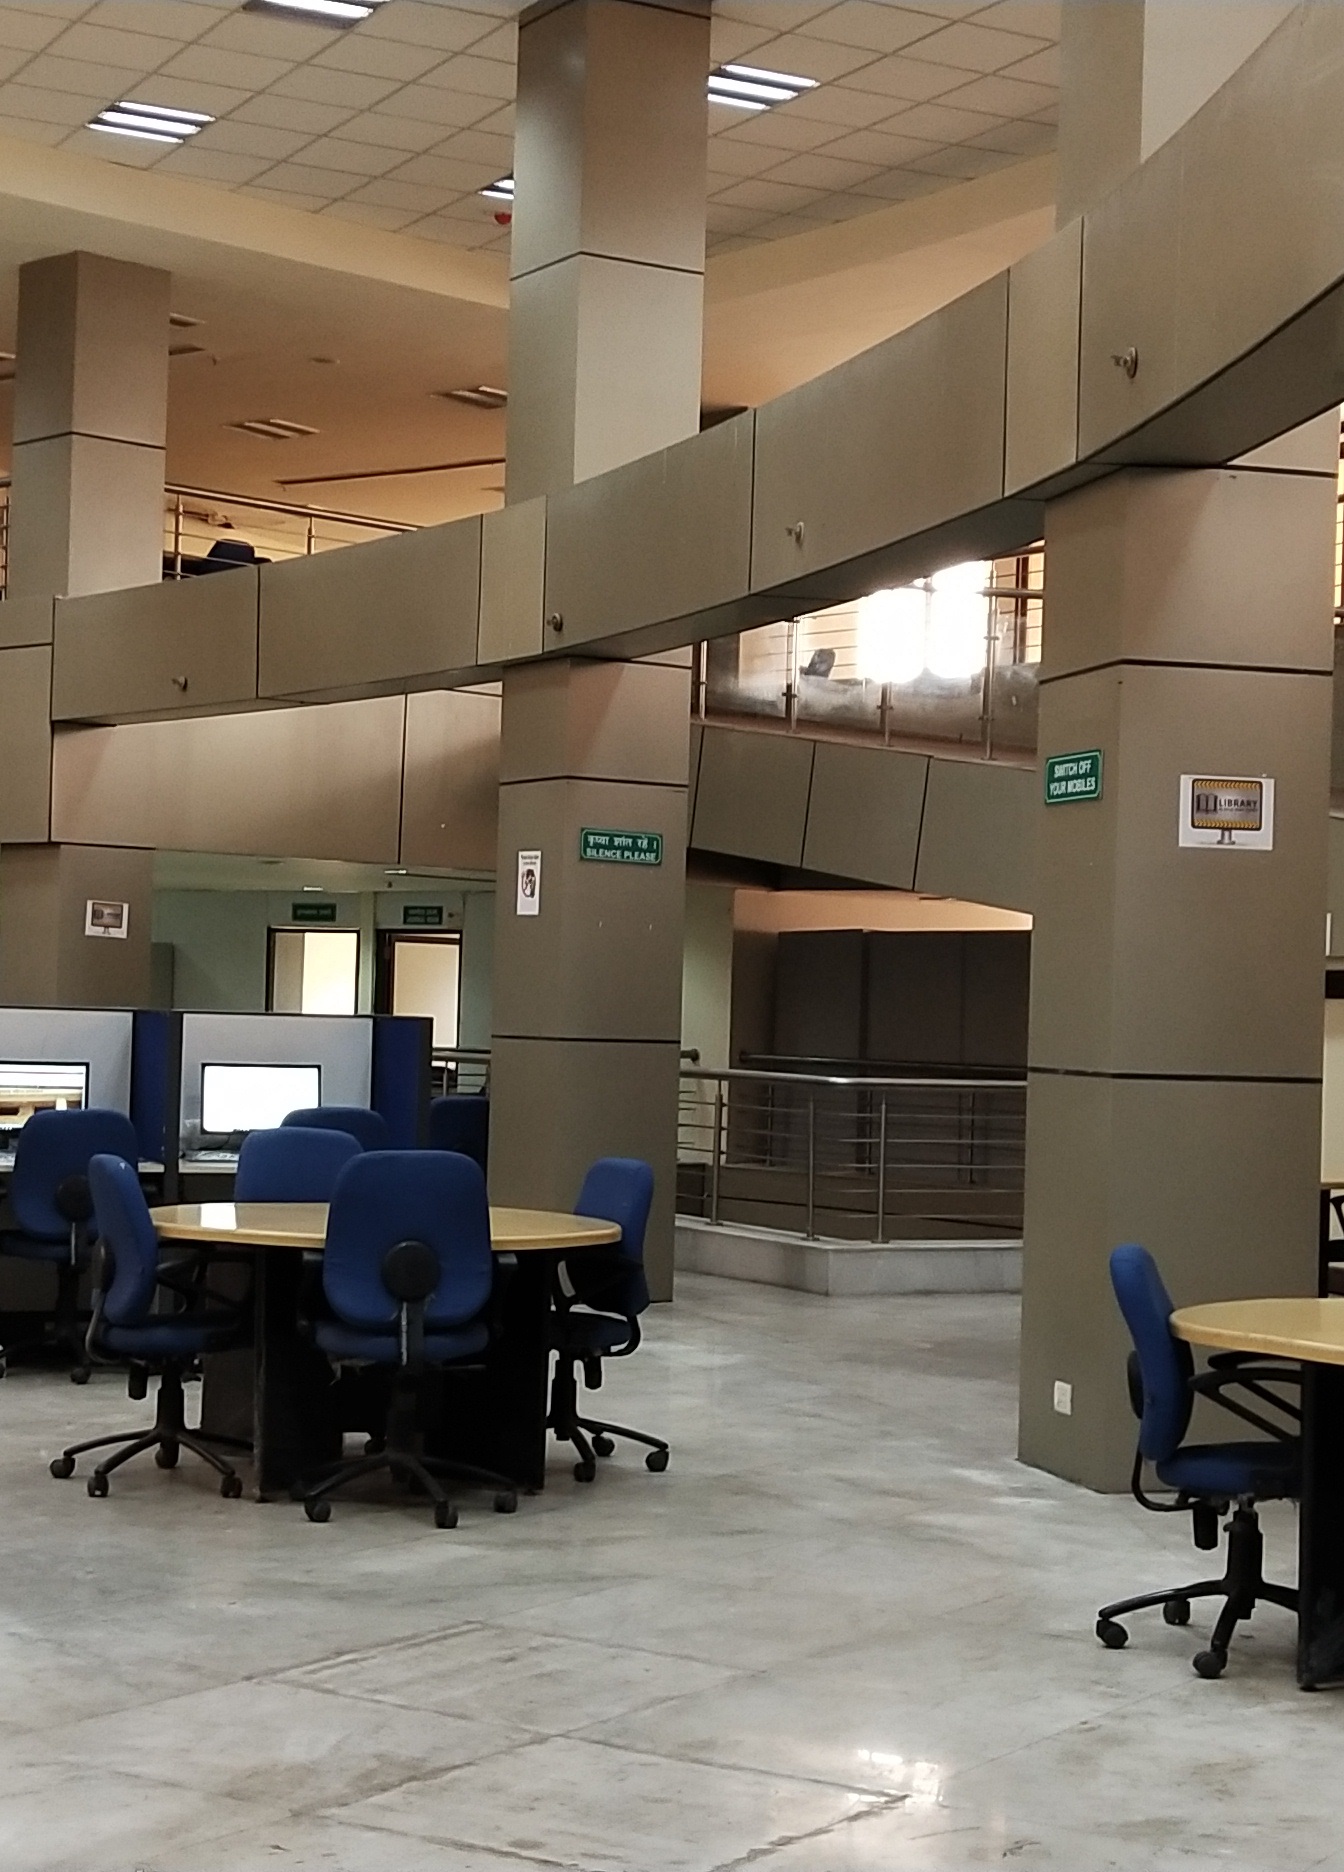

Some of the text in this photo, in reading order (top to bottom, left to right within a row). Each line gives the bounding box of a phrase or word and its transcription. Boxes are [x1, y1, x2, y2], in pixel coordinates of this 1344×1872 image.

[1054, 759, 1092, 778] SWITCH OFF
[1049, 776, 1096, 796] YOUR MOBILES
[1218, 798, 1258, 808] LIBRARY
[586, 848, 657, 862] SILENCE PLEASE
